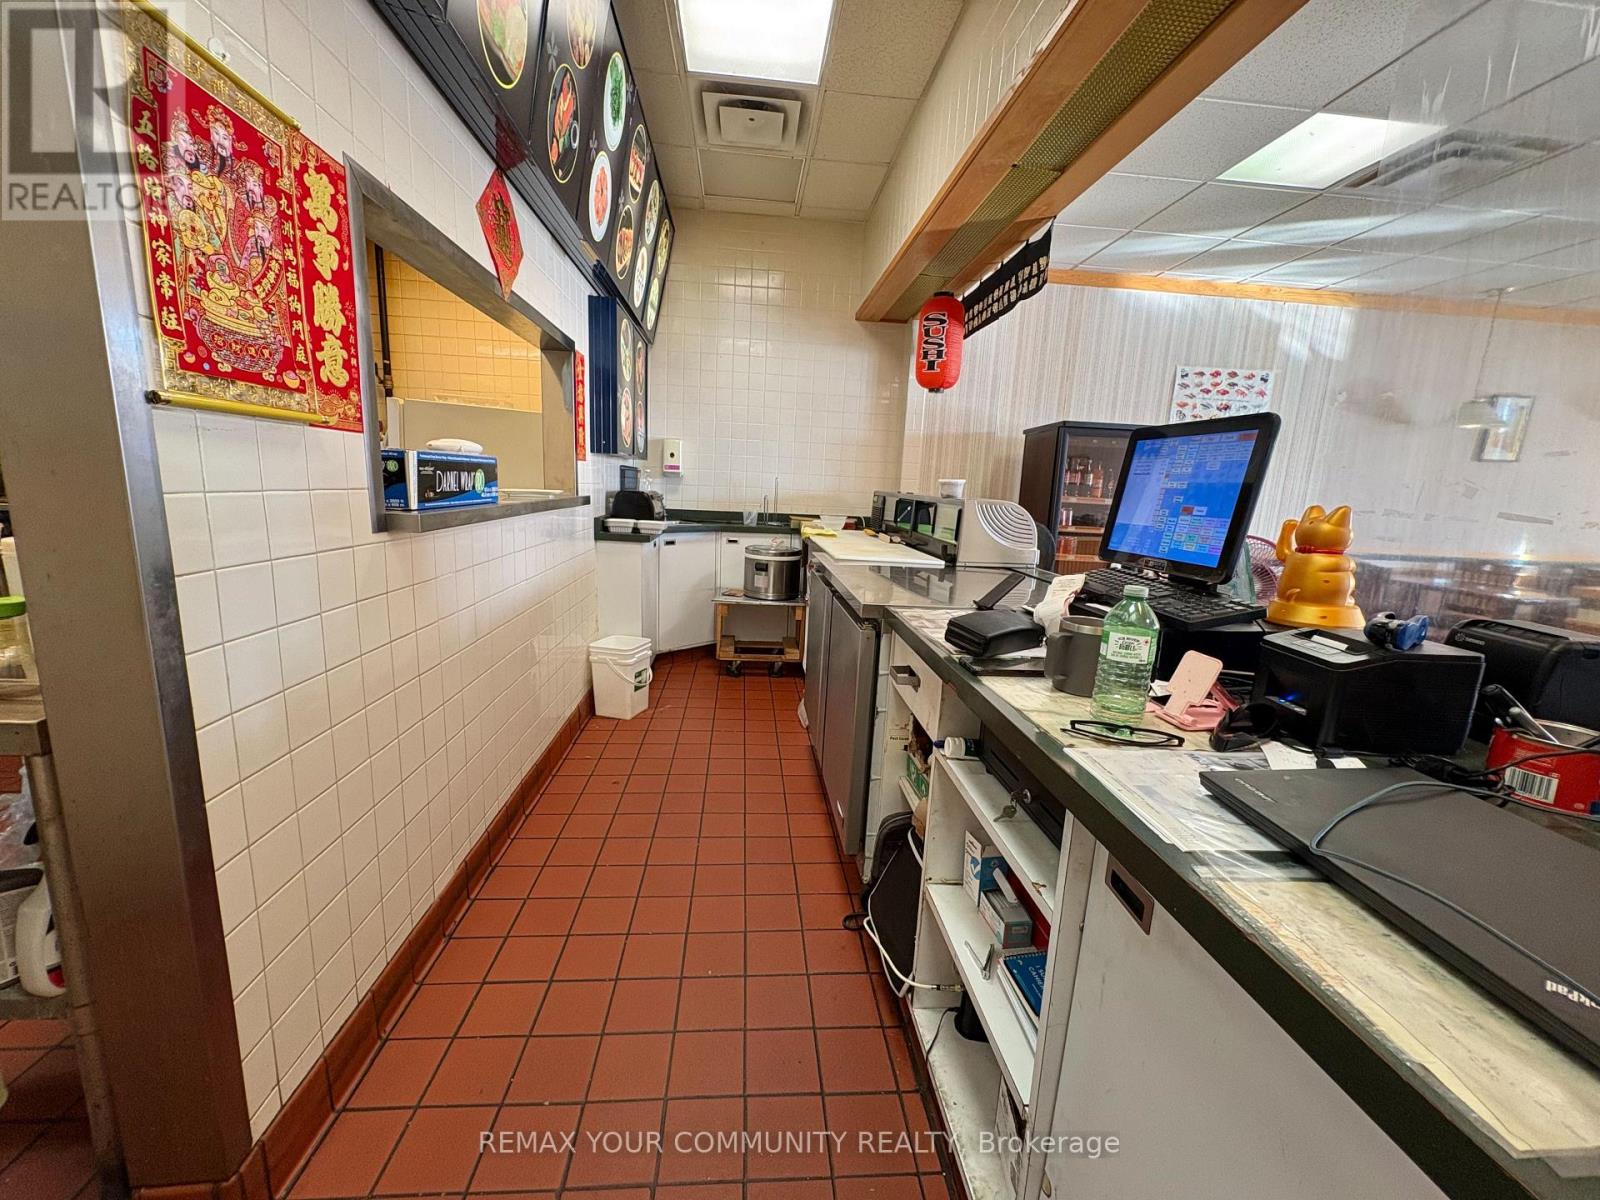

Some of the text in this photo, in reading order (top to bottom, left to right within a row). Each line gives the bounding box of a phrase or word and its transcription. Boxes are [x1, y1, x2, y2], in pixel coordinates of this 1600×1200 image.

[303, 168, 349, 388] 萬事勝意
[921, 312, 948, 372] SUSHI
[436, 470, 459, 492] DARNEL
[460, 471, 475, 491] WRAP
